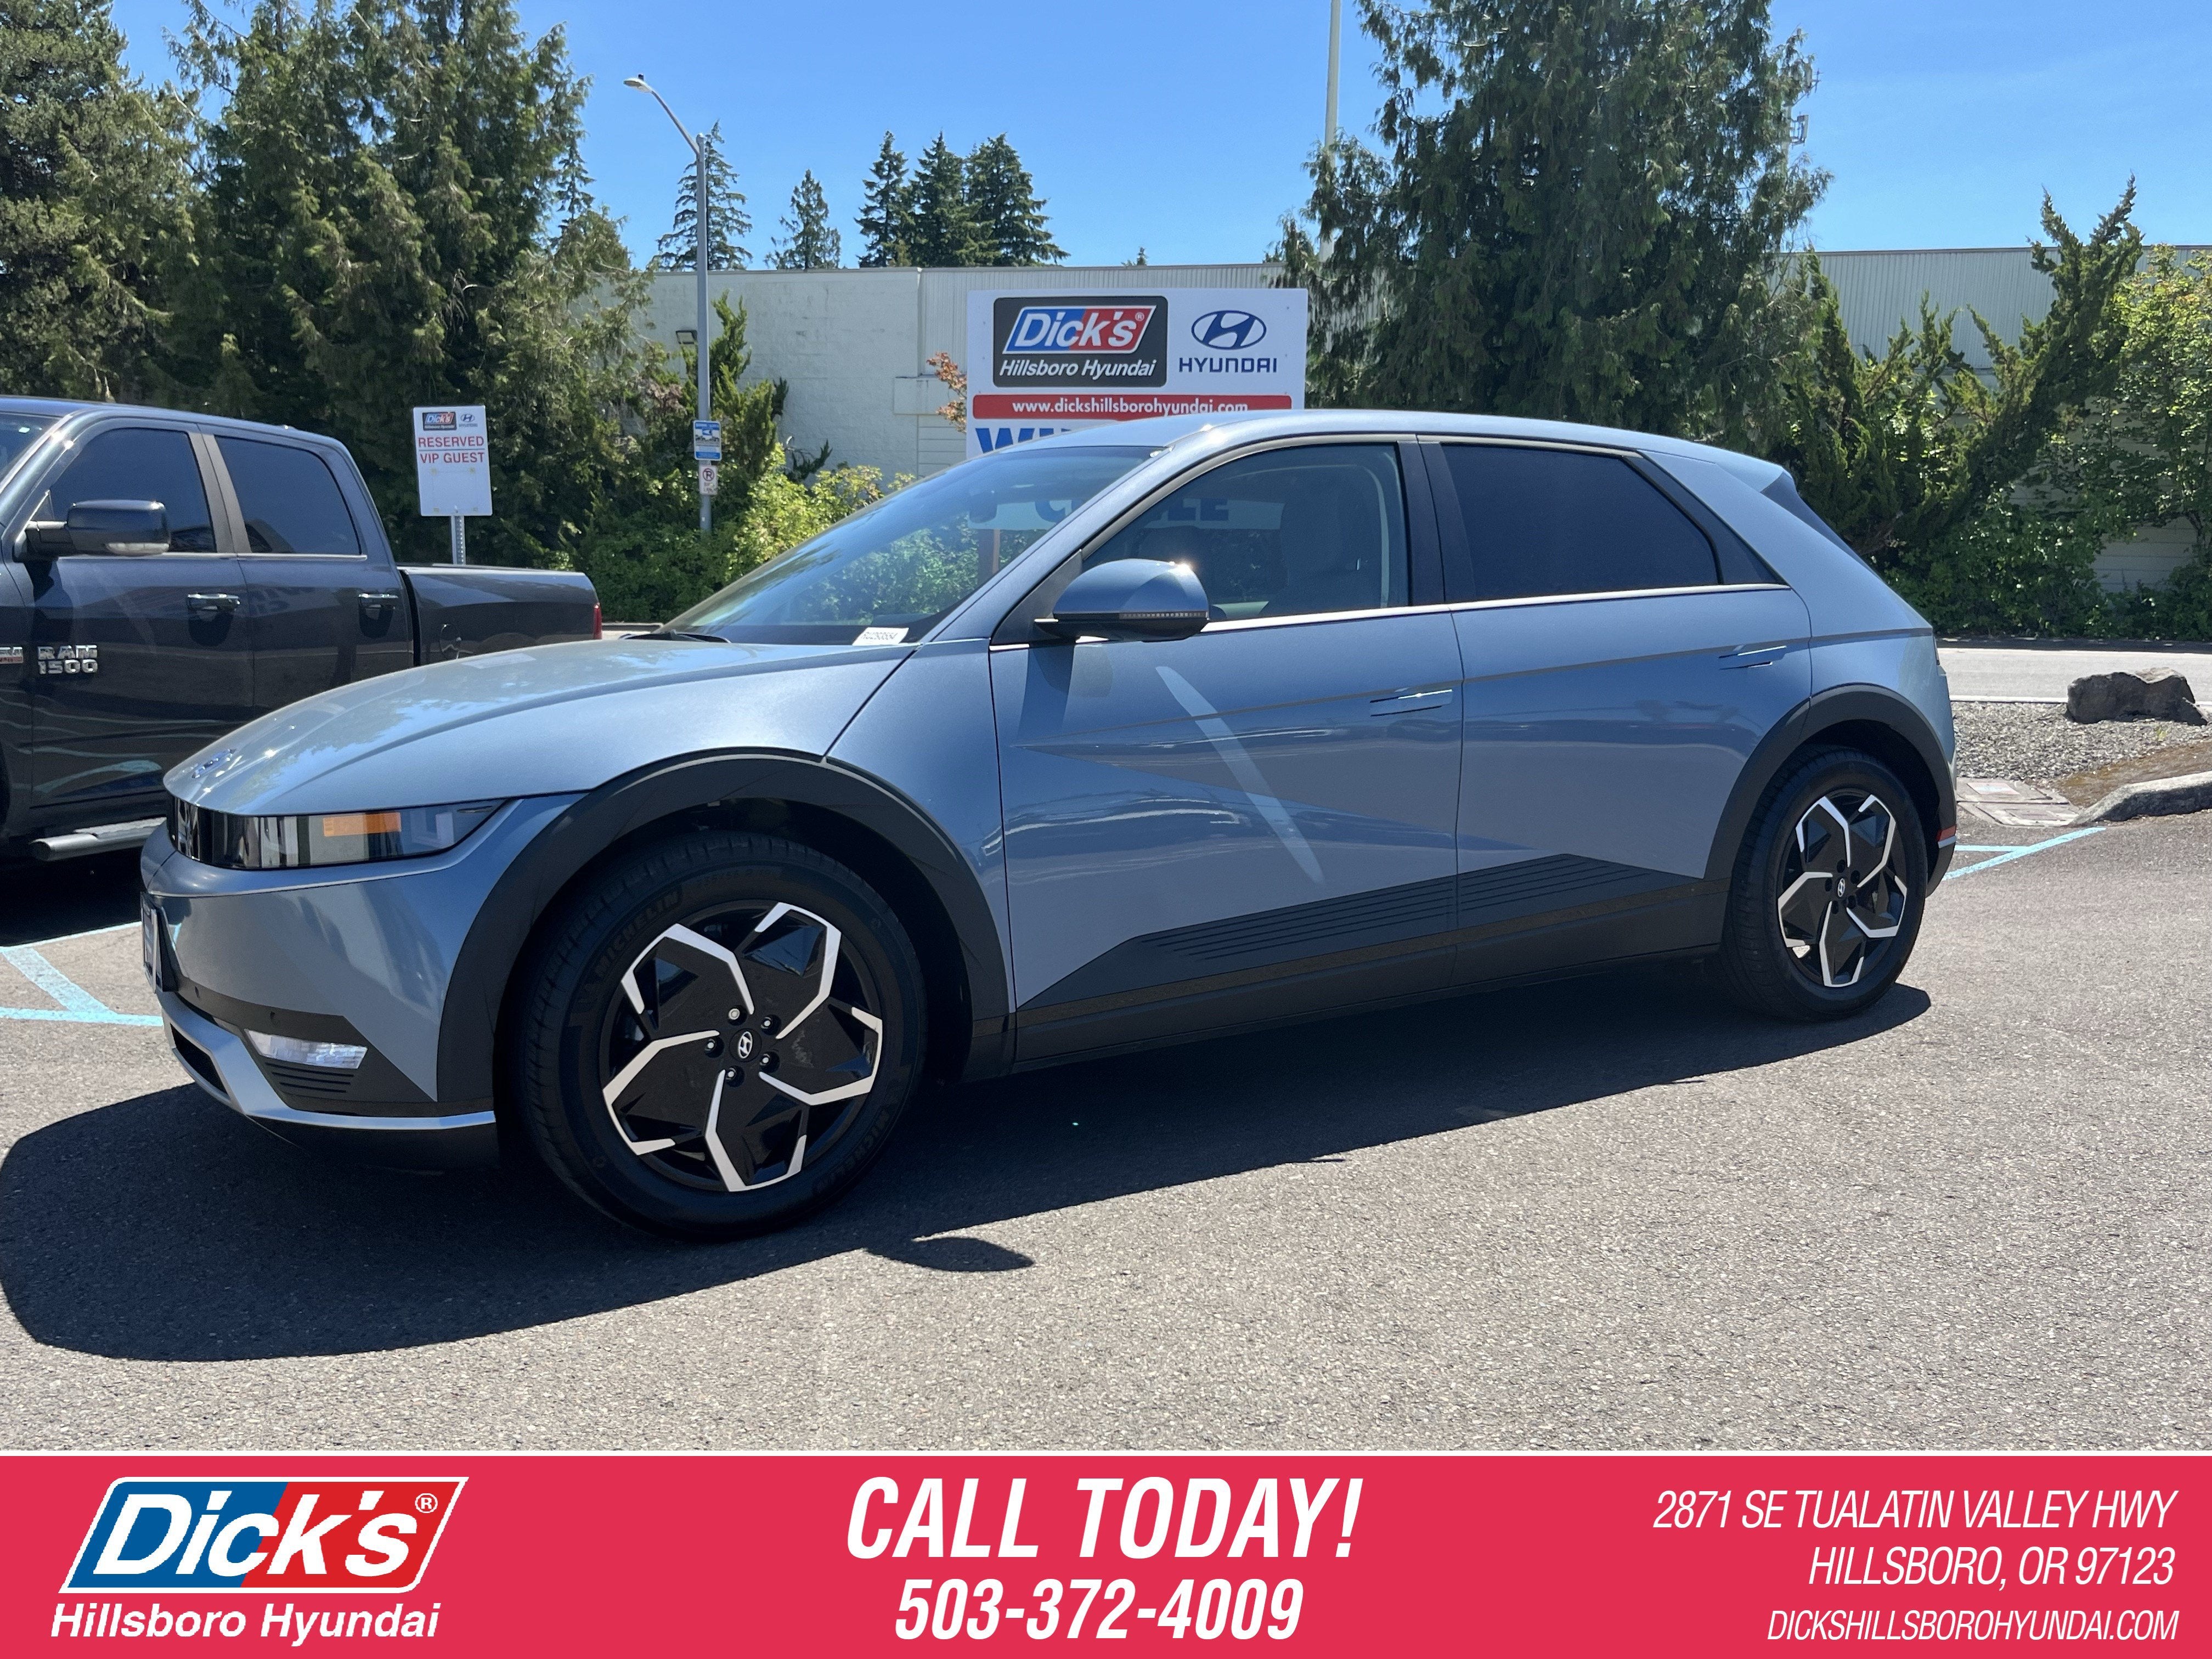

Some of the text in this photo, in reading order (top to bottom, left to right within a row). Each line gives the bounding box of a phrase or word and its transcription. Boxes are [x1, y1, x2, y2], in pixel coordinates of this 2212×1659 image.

[1014, 311, 1137, 347] Dick's
[999, 359, 1156, 380] Hillsboro Hyundai
[1179, 357, 1277, 373] HYUNDAI
[1012, 397, 1248, 417] www.dickshillsborohyundai.com
[418, 436, 484, 448] RESERVED
[420, 452, 484, 464] VIP GUEST
[37, 645, 98, 659] RAM
[38, 659, 98, 674] 1500
